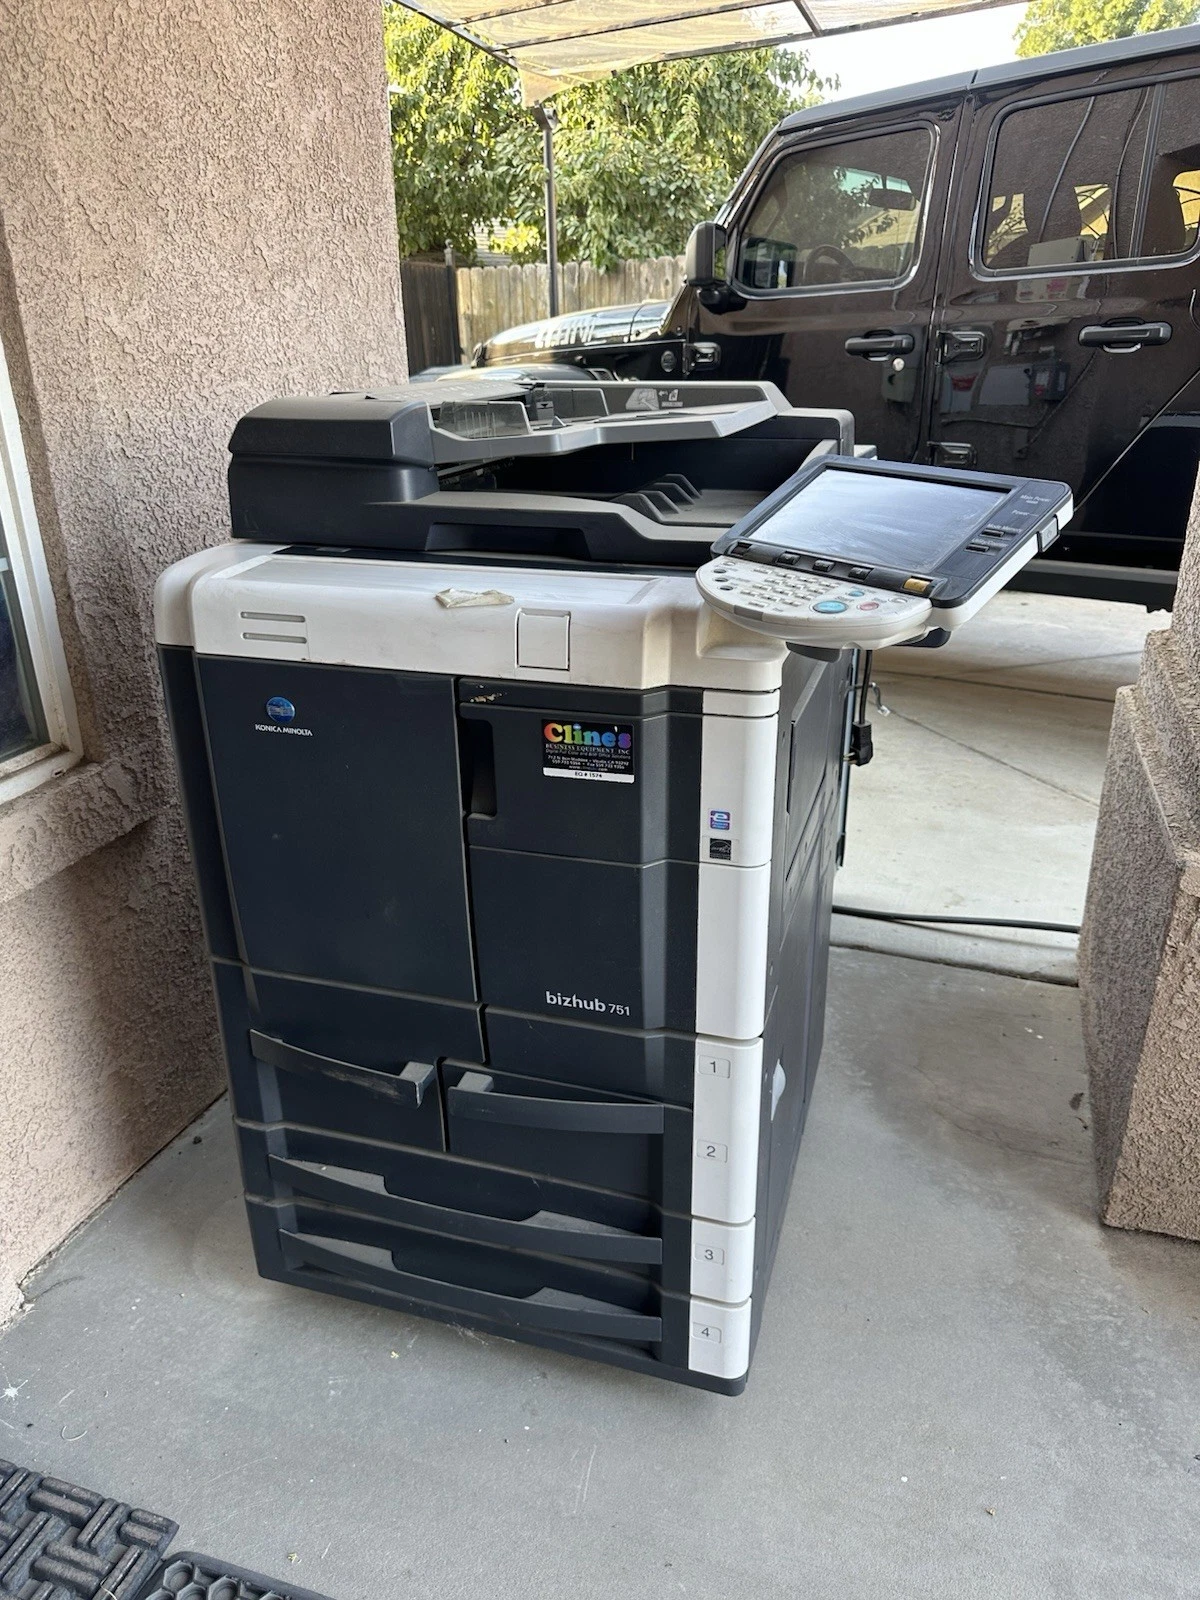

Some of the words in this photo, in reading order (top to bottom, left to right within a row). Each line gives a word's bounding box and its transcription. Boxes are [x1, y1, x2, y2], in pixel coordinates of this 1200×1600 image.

[255, 724, 282, 733] KONICA
[283, 727, 313, 736] MINOLTA
[544, 722, 632, 749] Cline's
[576, 745, 614, 753] EQUIPMENT
[546, 991, 606, 1012] bizhub
[608, 1004, 630, 1016] 751
[710, 1061, 716, 1073] 1
[706, 1145, 716, 1158] 2
[704, 1249, 714, 1261] 3
[701, 1327, 710, 1338] 4
